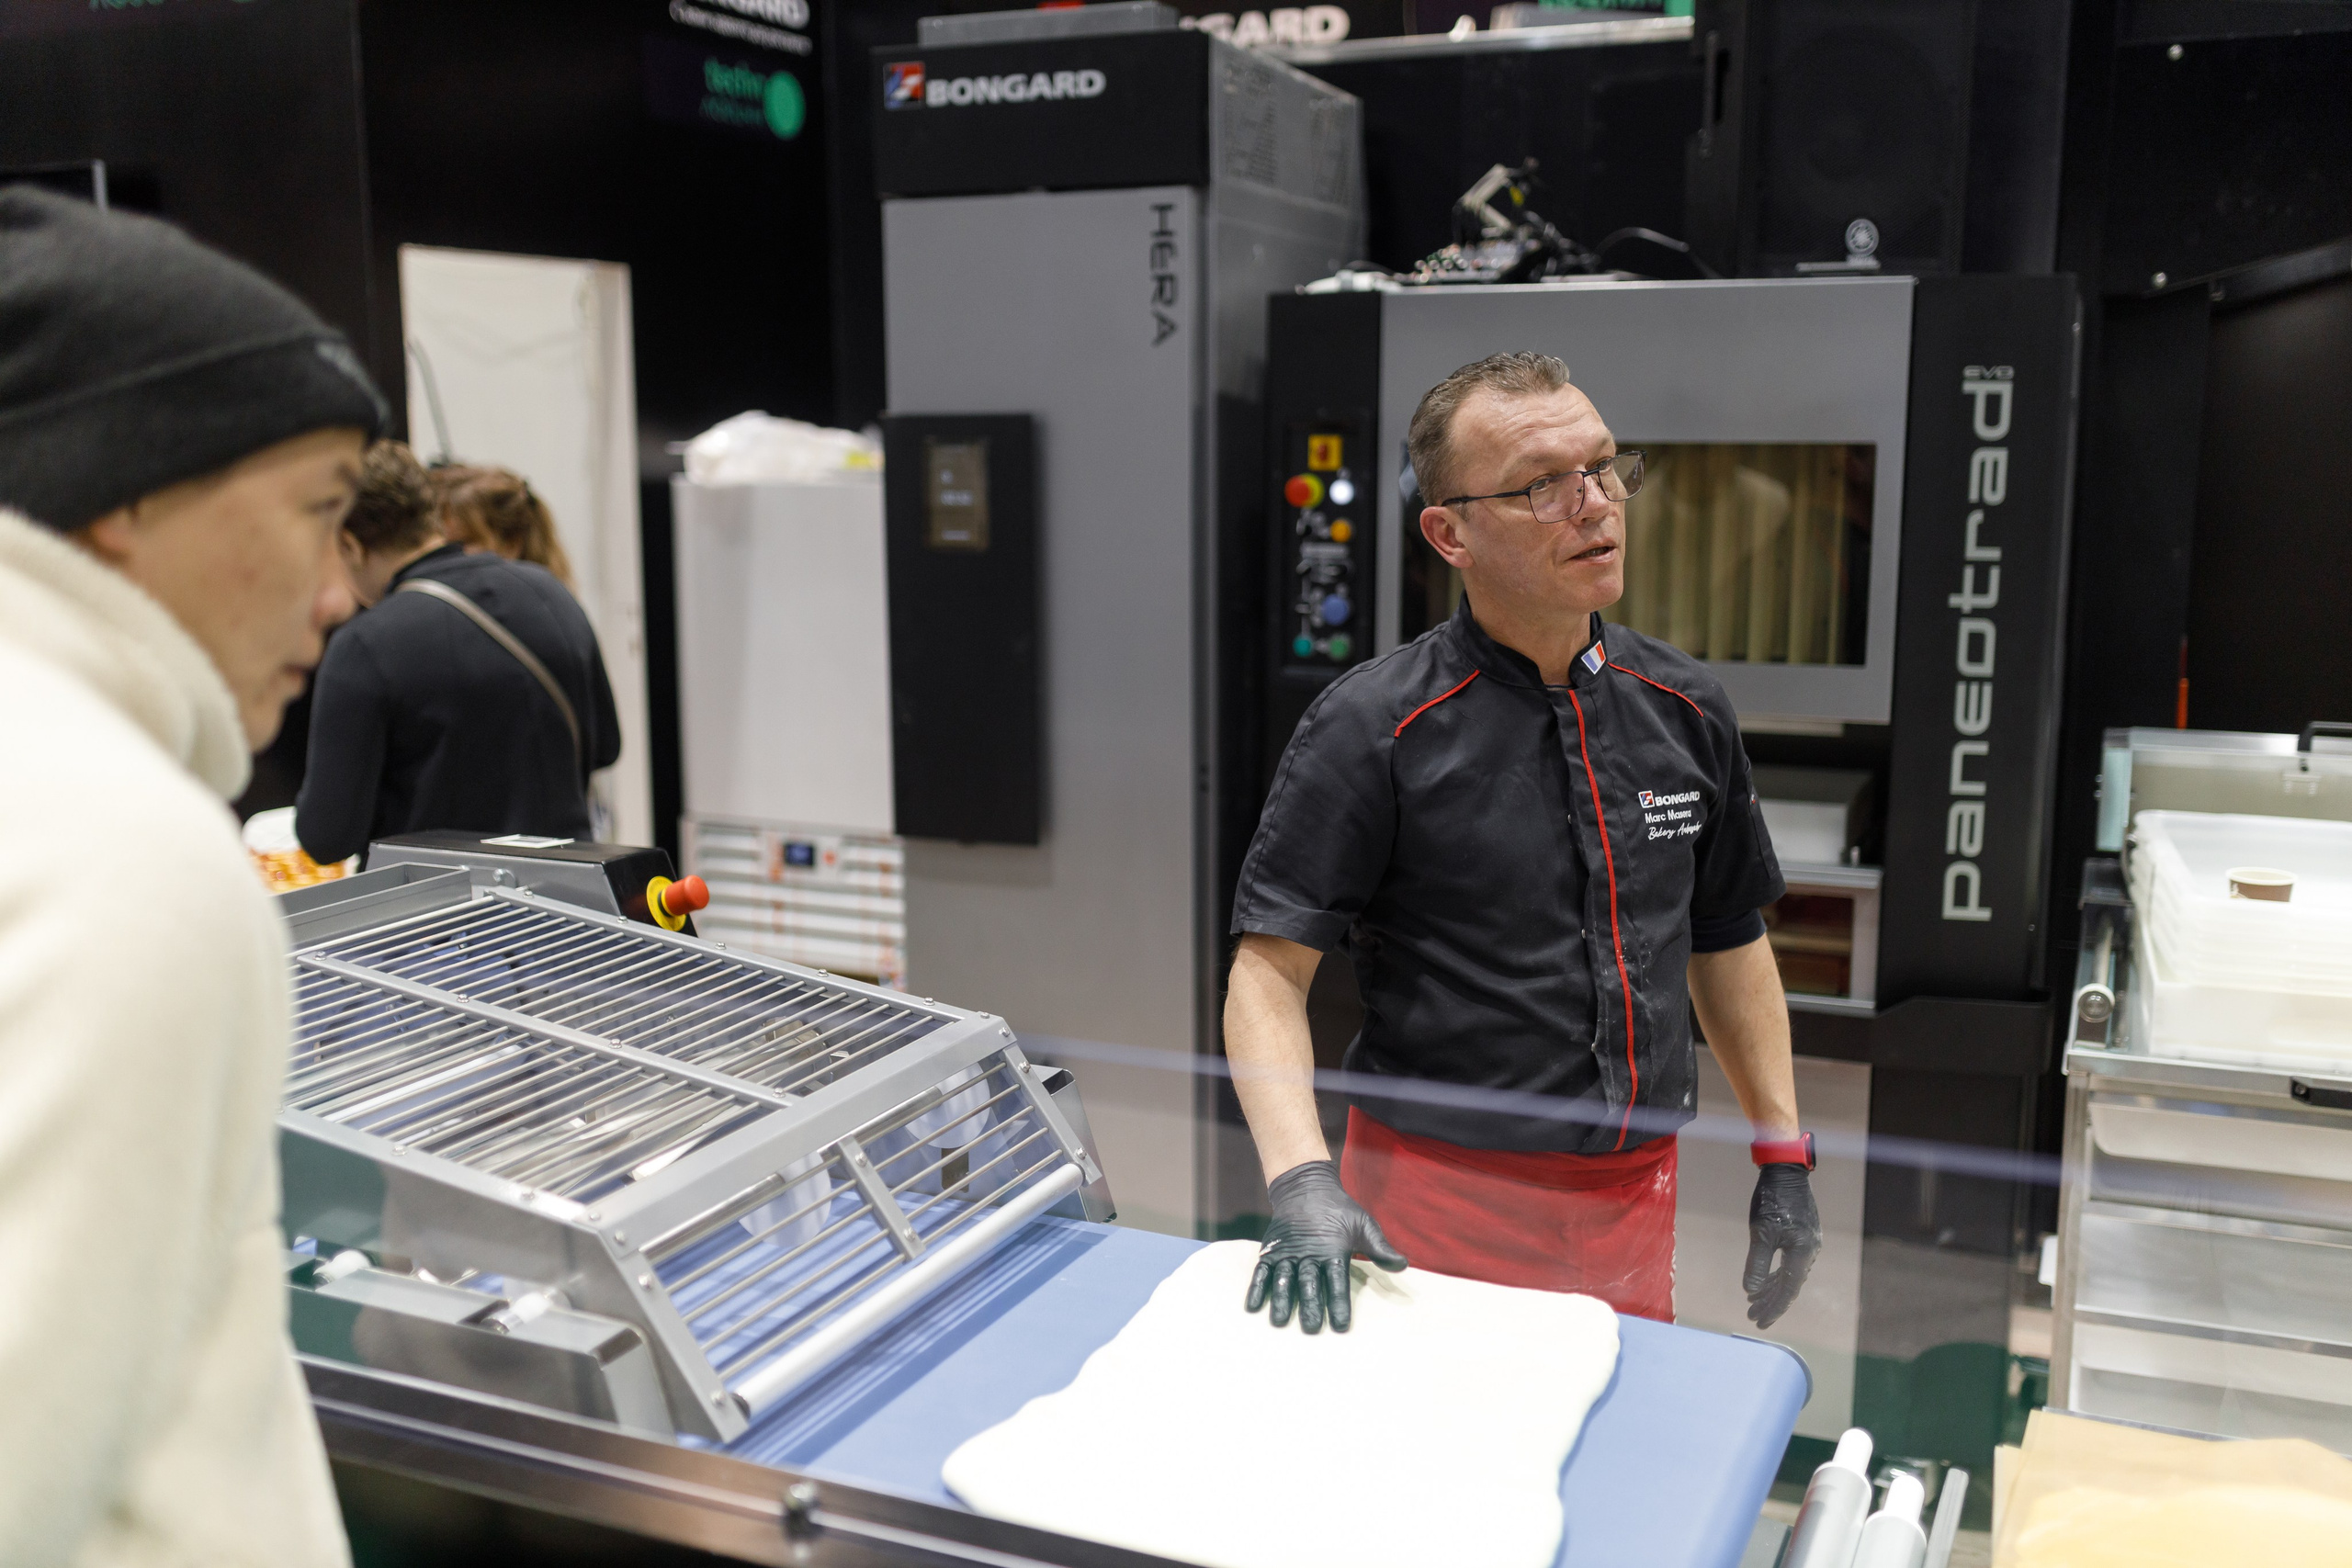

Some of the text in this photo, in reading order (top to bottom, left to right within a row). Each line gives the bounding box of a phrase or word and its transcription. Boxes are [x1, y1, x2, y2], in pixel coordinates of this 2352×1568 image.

[925, 69, 1106, 107] BONGARD
[1150, 204, 1179, 347] HERA
[1941, 379, 2014, 921] paneotrad
[1645, 812, 1667, 824] Marc
[1655, 791, 1701, 807] BONGARD
